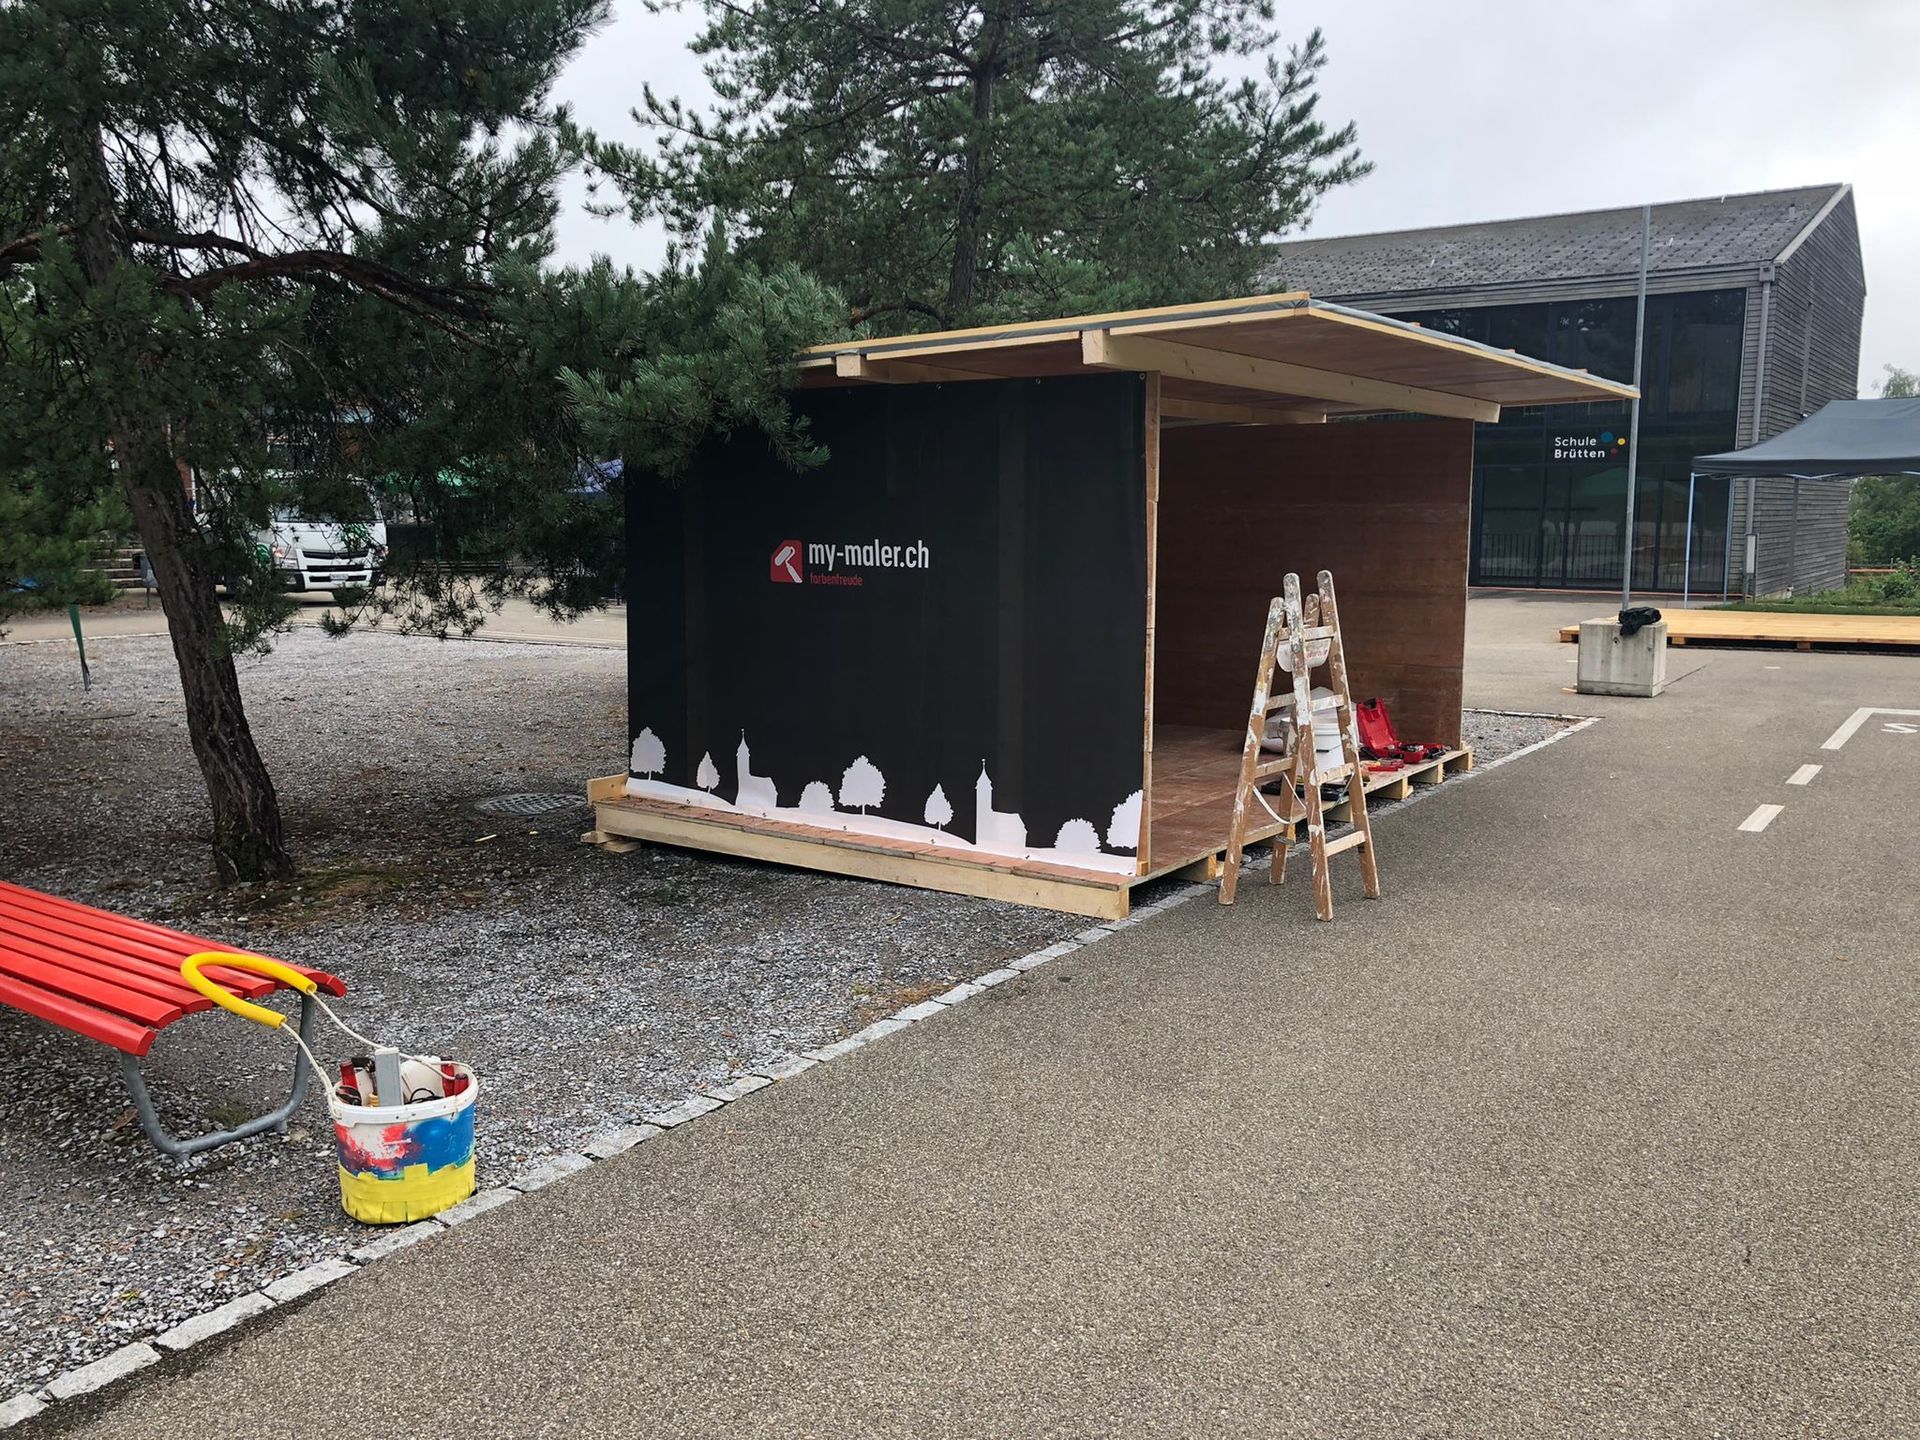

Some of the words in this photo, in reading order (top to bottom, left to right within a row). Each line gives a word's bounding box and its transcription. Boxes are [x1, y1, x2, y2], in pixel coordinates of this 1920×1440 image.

[1554, 436, 1597, 447] Schule
[1554, 448, 1606, 459] Brütten
[808, 538, 930, 571] my-maler.ch
